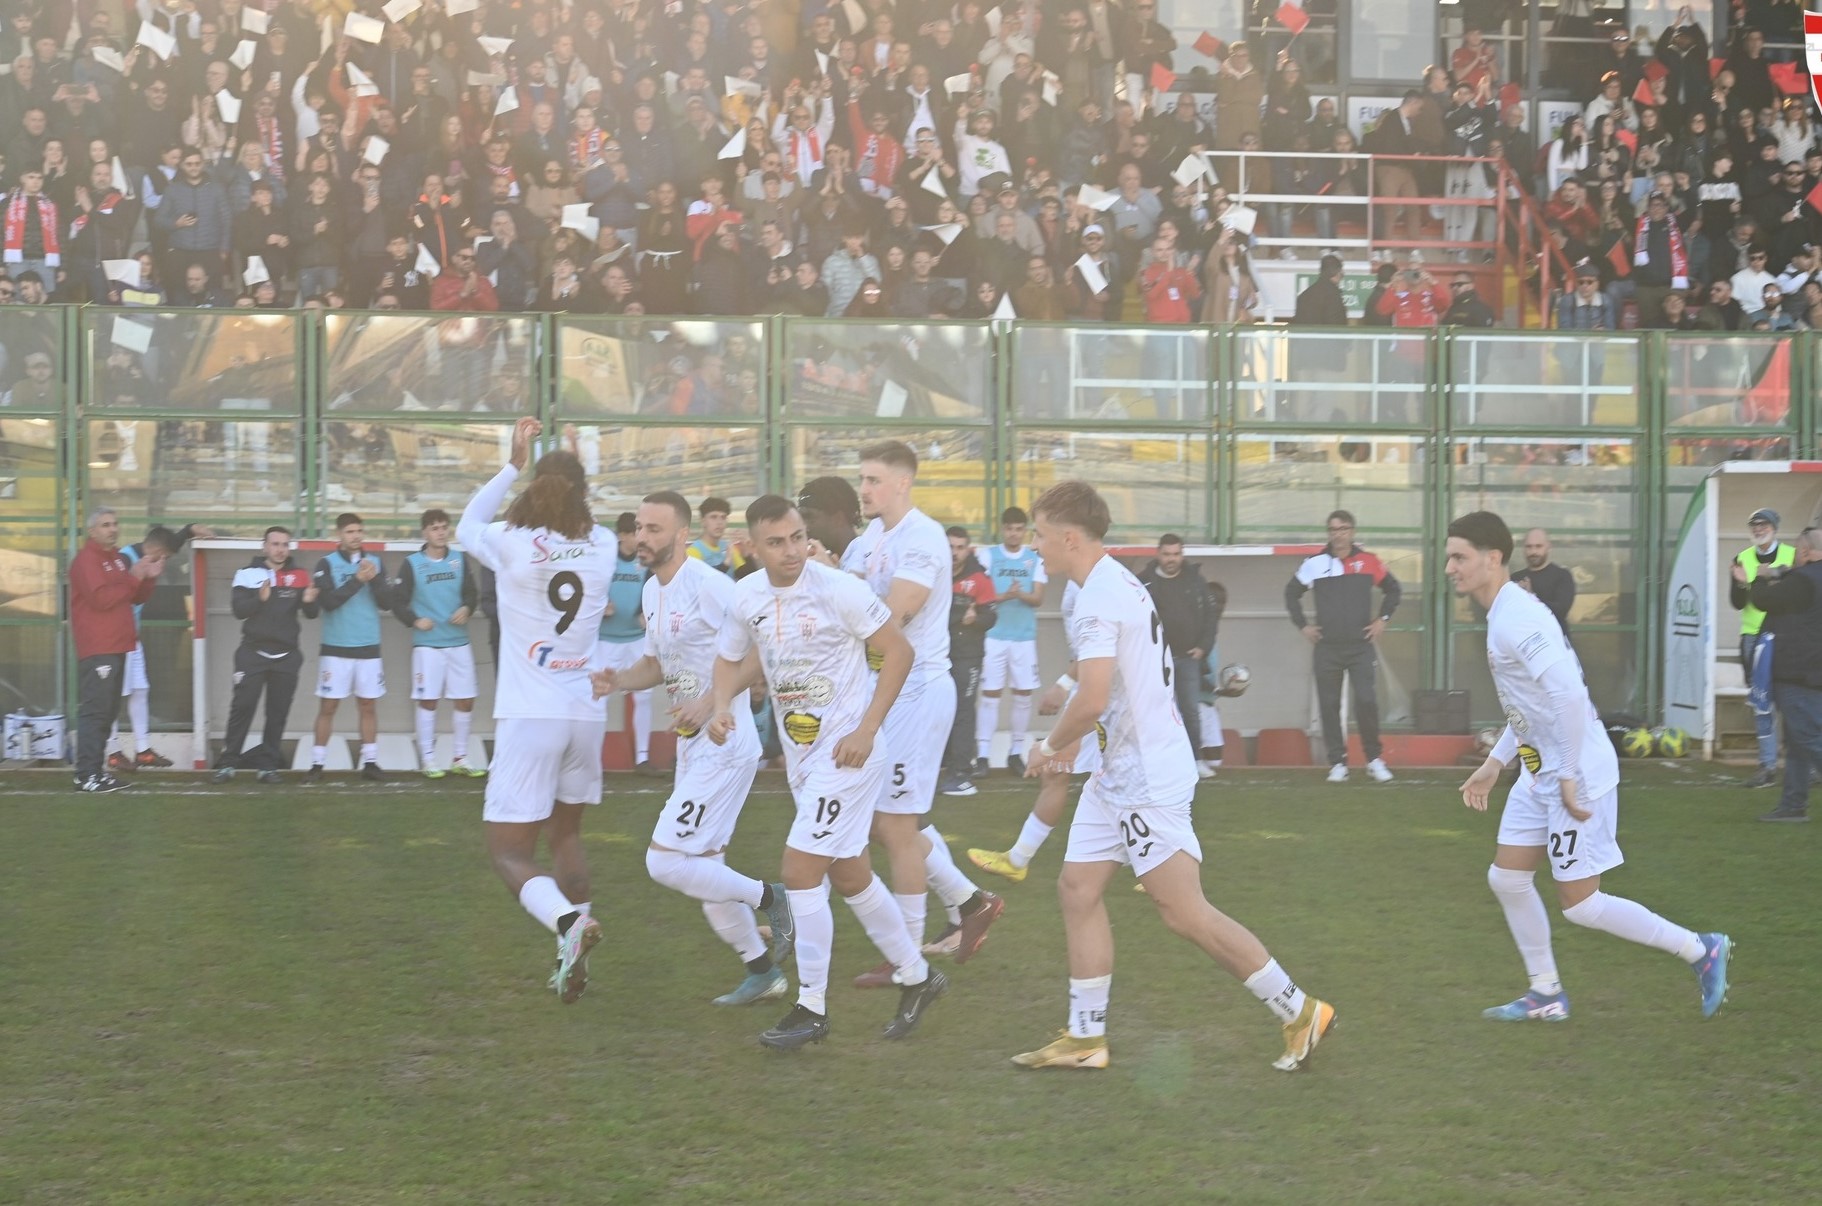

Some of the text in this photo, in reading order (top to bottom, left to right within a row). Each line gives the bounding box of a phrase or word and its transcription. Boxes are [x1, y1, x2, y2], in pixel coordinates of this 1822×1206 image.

[548, 570, 584, 635] 9
[892, 763, 905, 786] 5
[676, 800, 706, 828] 21
[816, 797, 841, 825] 19
[1120, 812, 1150, 847] 20
[1550, 829, 1577, 857] 27
